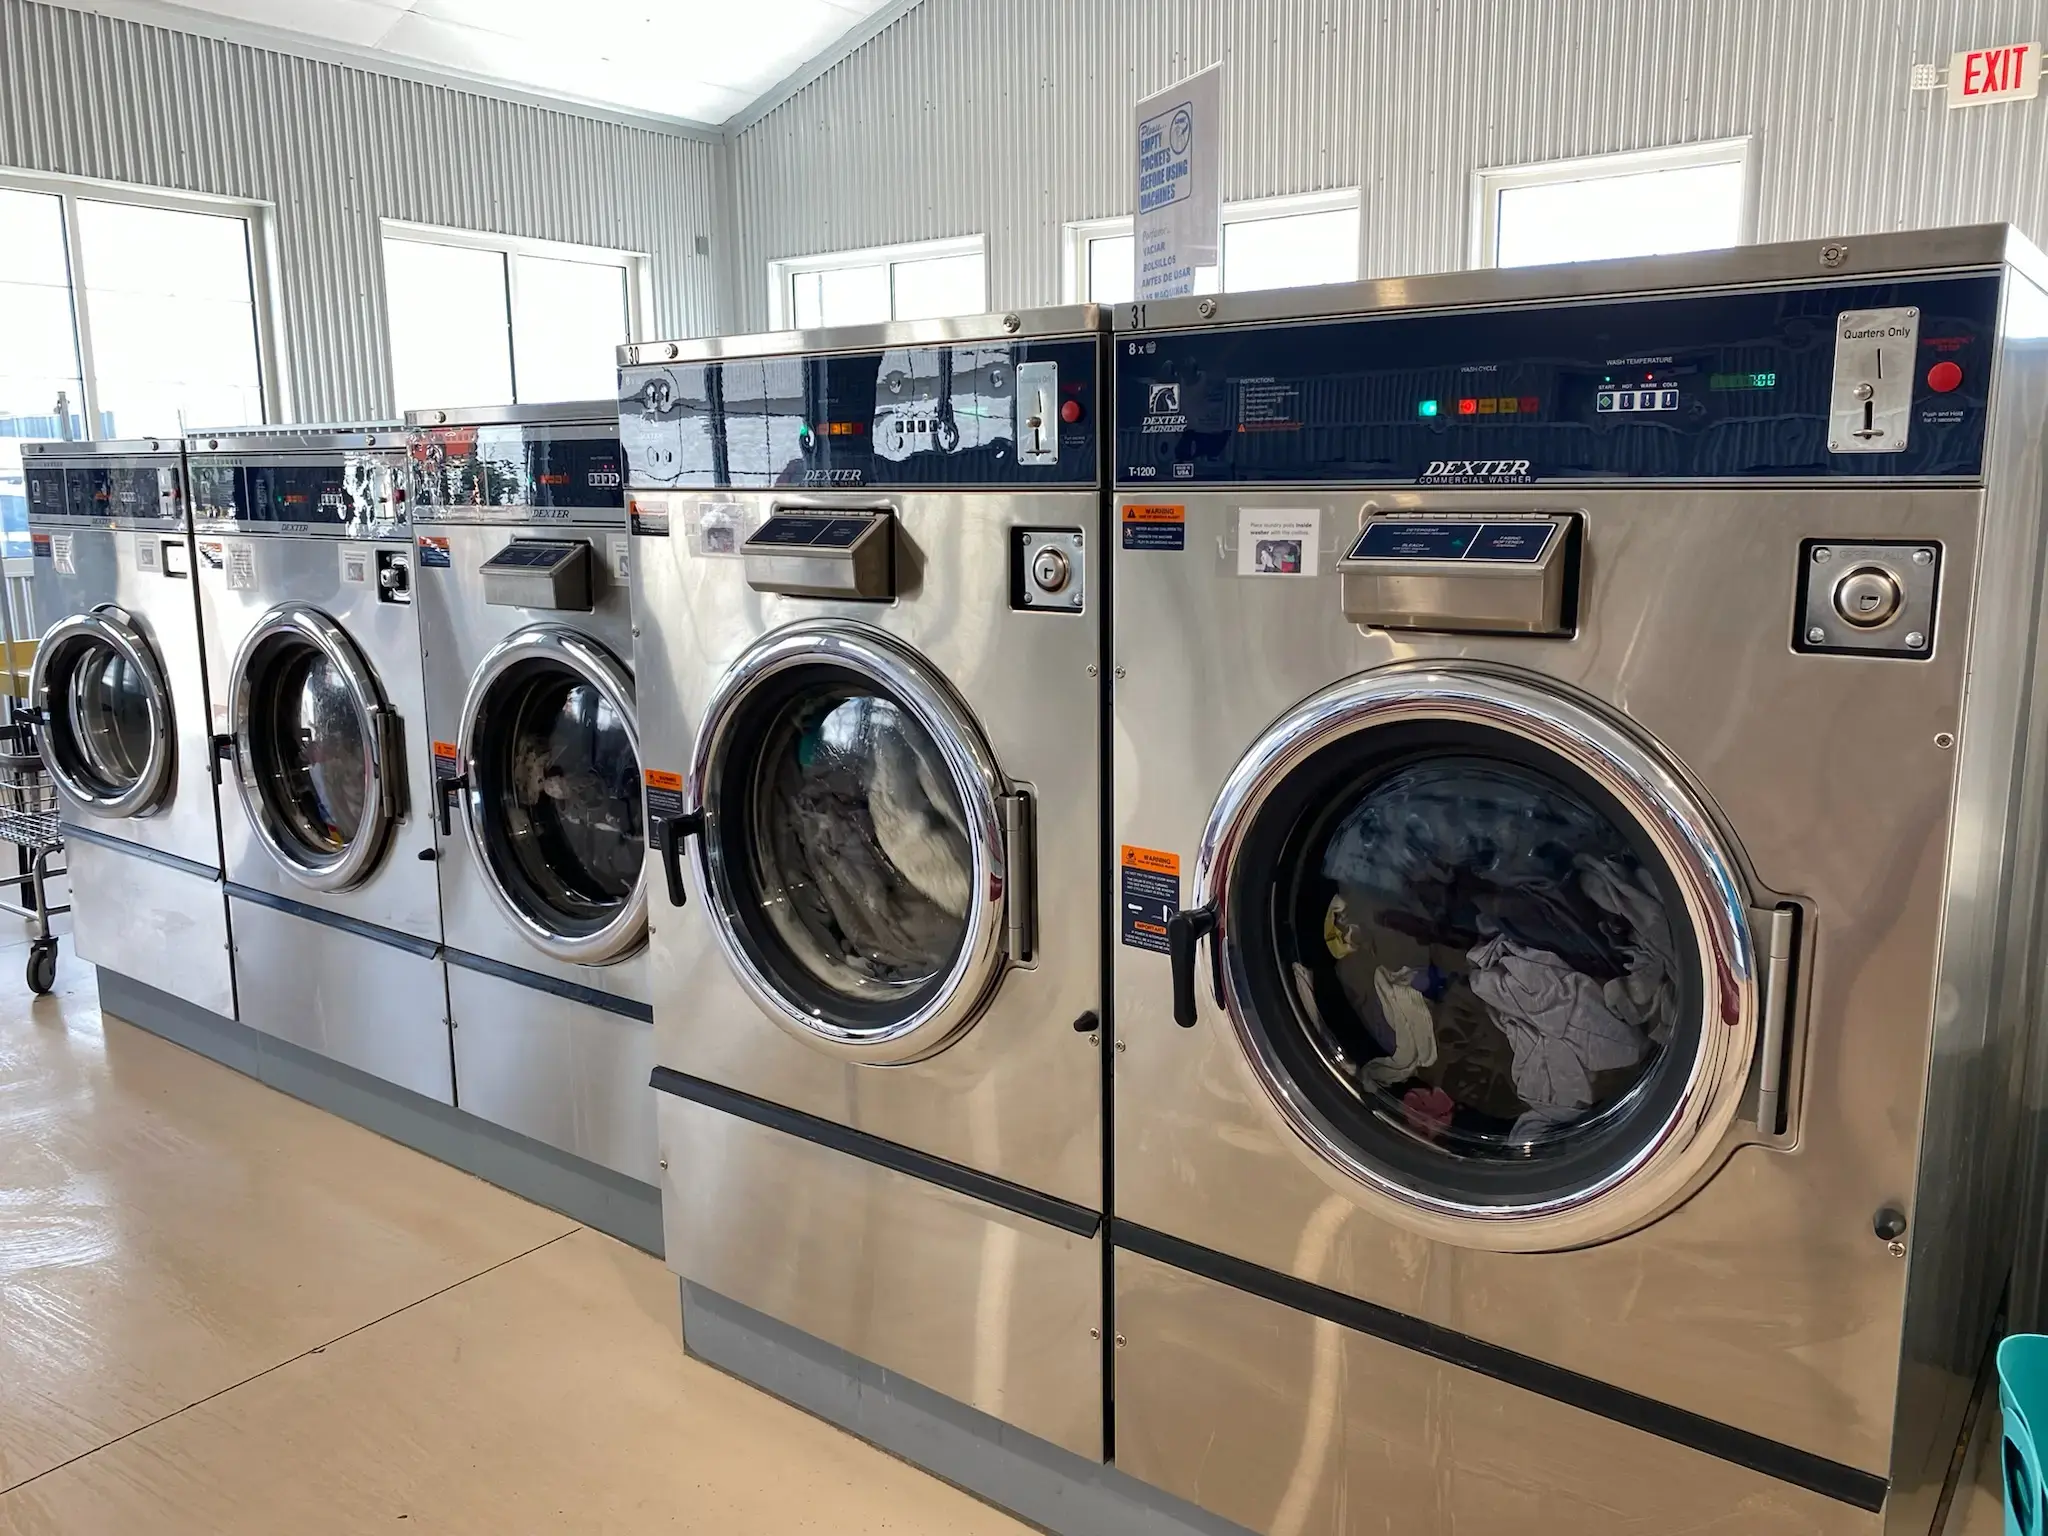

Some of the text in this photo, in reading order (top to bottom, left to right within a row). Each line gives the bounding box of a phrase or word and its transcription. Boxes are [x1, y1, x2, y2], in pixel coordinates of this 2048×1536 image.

[1964, 46, 2028, 95] EXIT
[1141, 132, 1162, 155] EMPTY
[1141, 147, 1171, 173] POCKETS
[1141, 159, 1188, 192] BEFORE USING
[1140, 183, 1175, 210] MACHINES
[1143, 242, 1165, 256] VACIAR
[1143, 255, 1176, 272] BOLSILLOS
[1142, 267, 1191, 288] ANTES DE USAR
[1131, 304, 1146, 329] 31
[1844, 327, 1911, 340] Quarters Only
[628, 346, 640, 365] 30
[1129, 343, 1144, 355] 8 x
[1626, 356, 1673, 365] TEMPERATURE
[1142, 415, 1185, 425] DEXTER
[1142, 424, 1187, 433] LAUNDRY
[1129, 467, 1156, 477] T-1200
[1422, 460, 1530, 476] DEXTER
[803, 469, 861, 481] DEXTER
[1419, 476, 1484, 484] COMMERCIAL
[532, 509, 570, 519] DEXTER
[281, 523, 308, 532] DEXTER
[1144, 855, 1171, 865] WARNING
[1136, 923, 1165, 933] IMPORTANT
